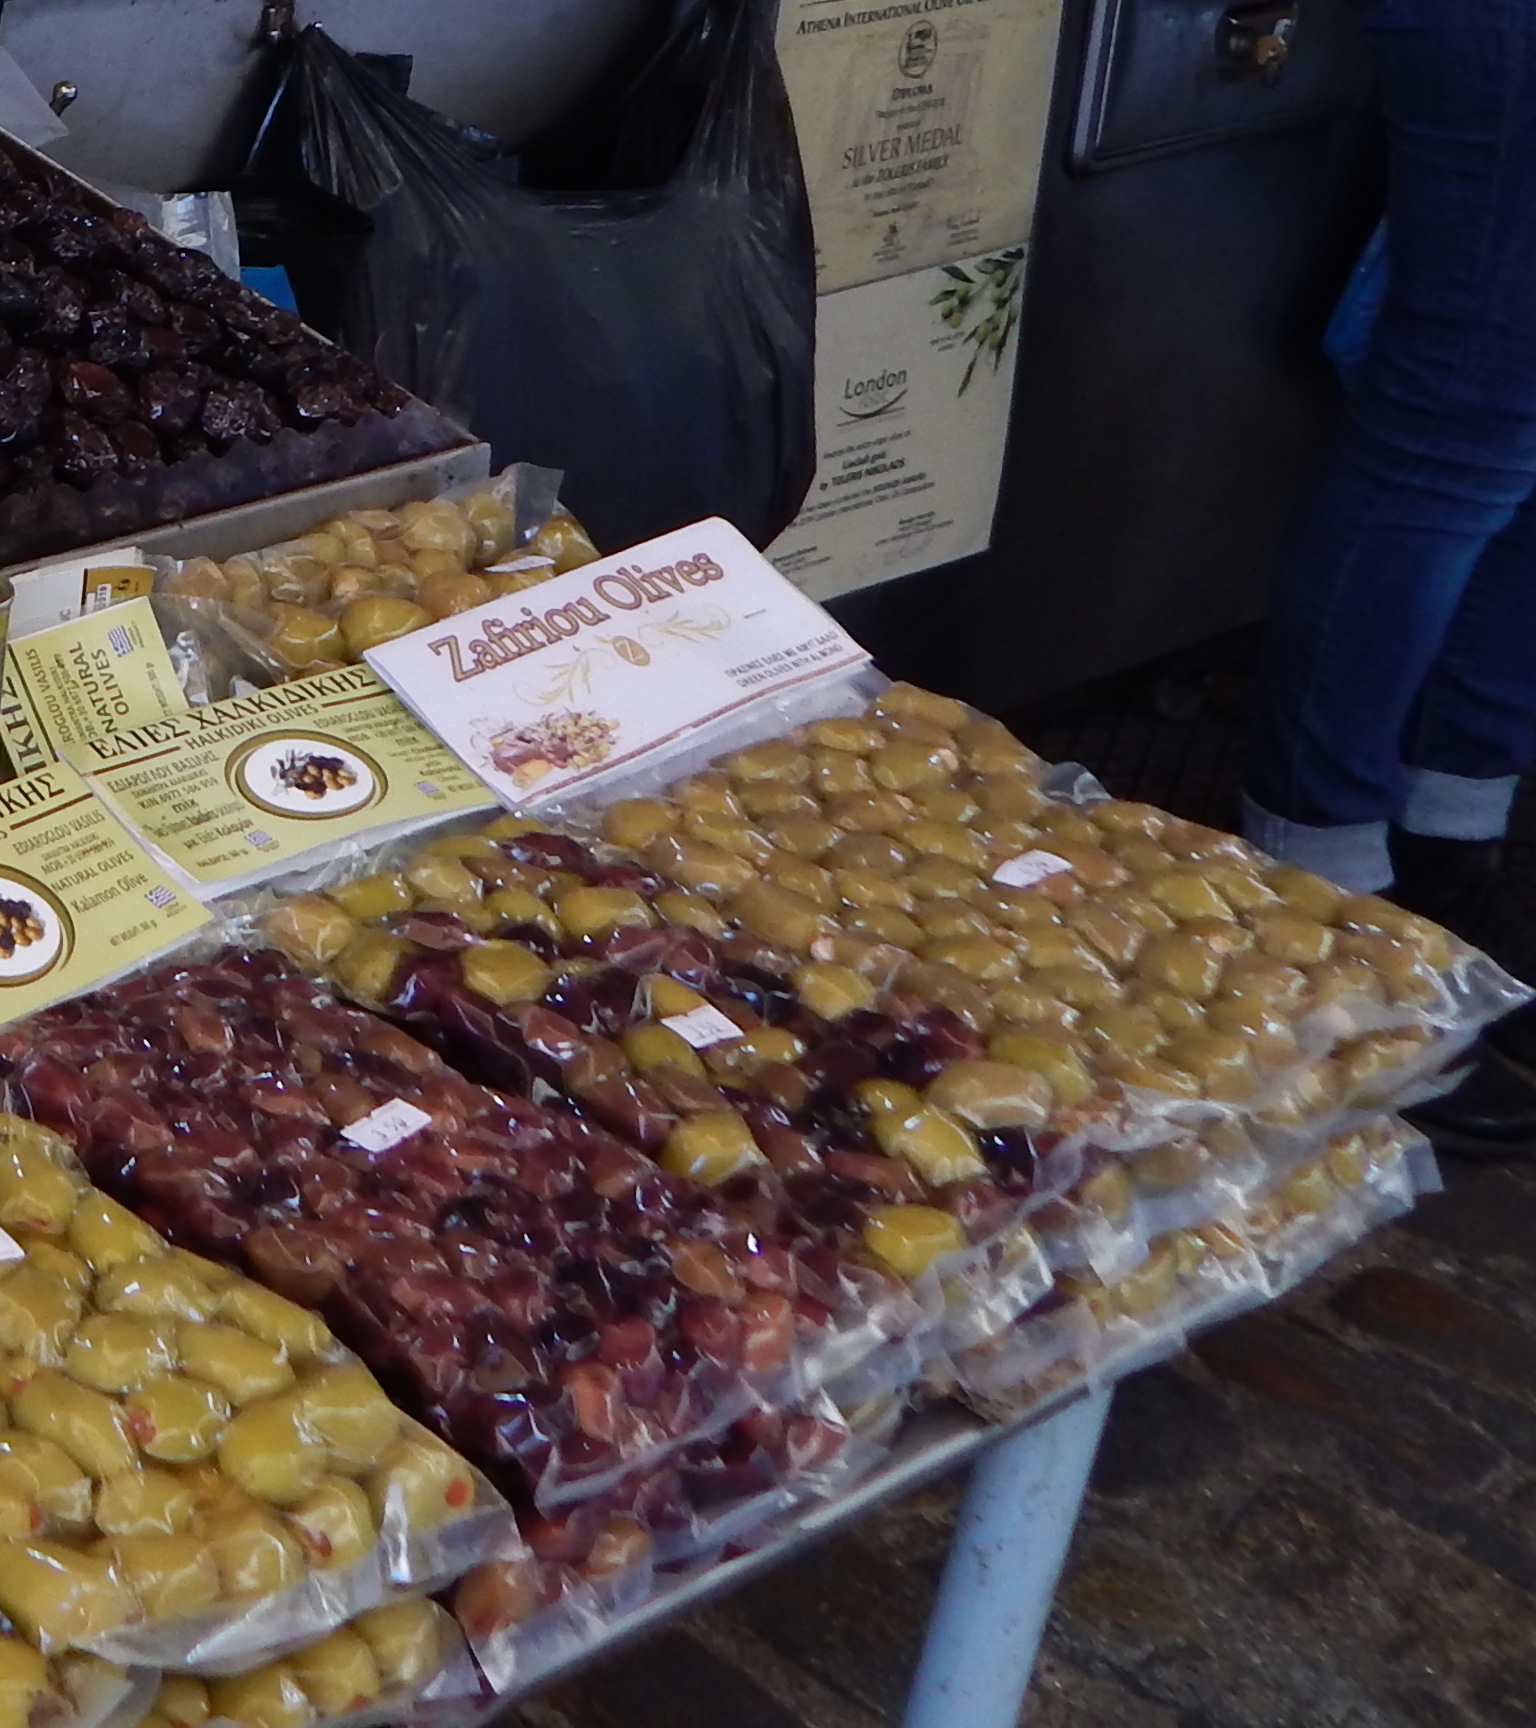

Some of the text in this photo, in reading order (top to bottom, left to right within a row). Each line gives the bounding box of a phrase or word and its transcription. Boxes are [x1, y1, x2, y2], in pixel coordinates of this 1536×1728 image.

[842, 124, 962, 170] SILVER MEDAL
[844, 369, 908, 400] London
[428, 552, 724, 684] Zafiriou Olives
[69, 641, 118, 734] NATURAL
[91, 648, 130, 716] OLIVES
[88, 668, 377, 760] ΕΛΙΕΣ ΧΑΛΚΙΔΙΚΗΣ
[188, 703, 319, 751] HALKIDIKI OLIVES
[51, 850, 135, 893] NATURAL OLIVES
[70, 872, 149, 913] Kalamon Olive
